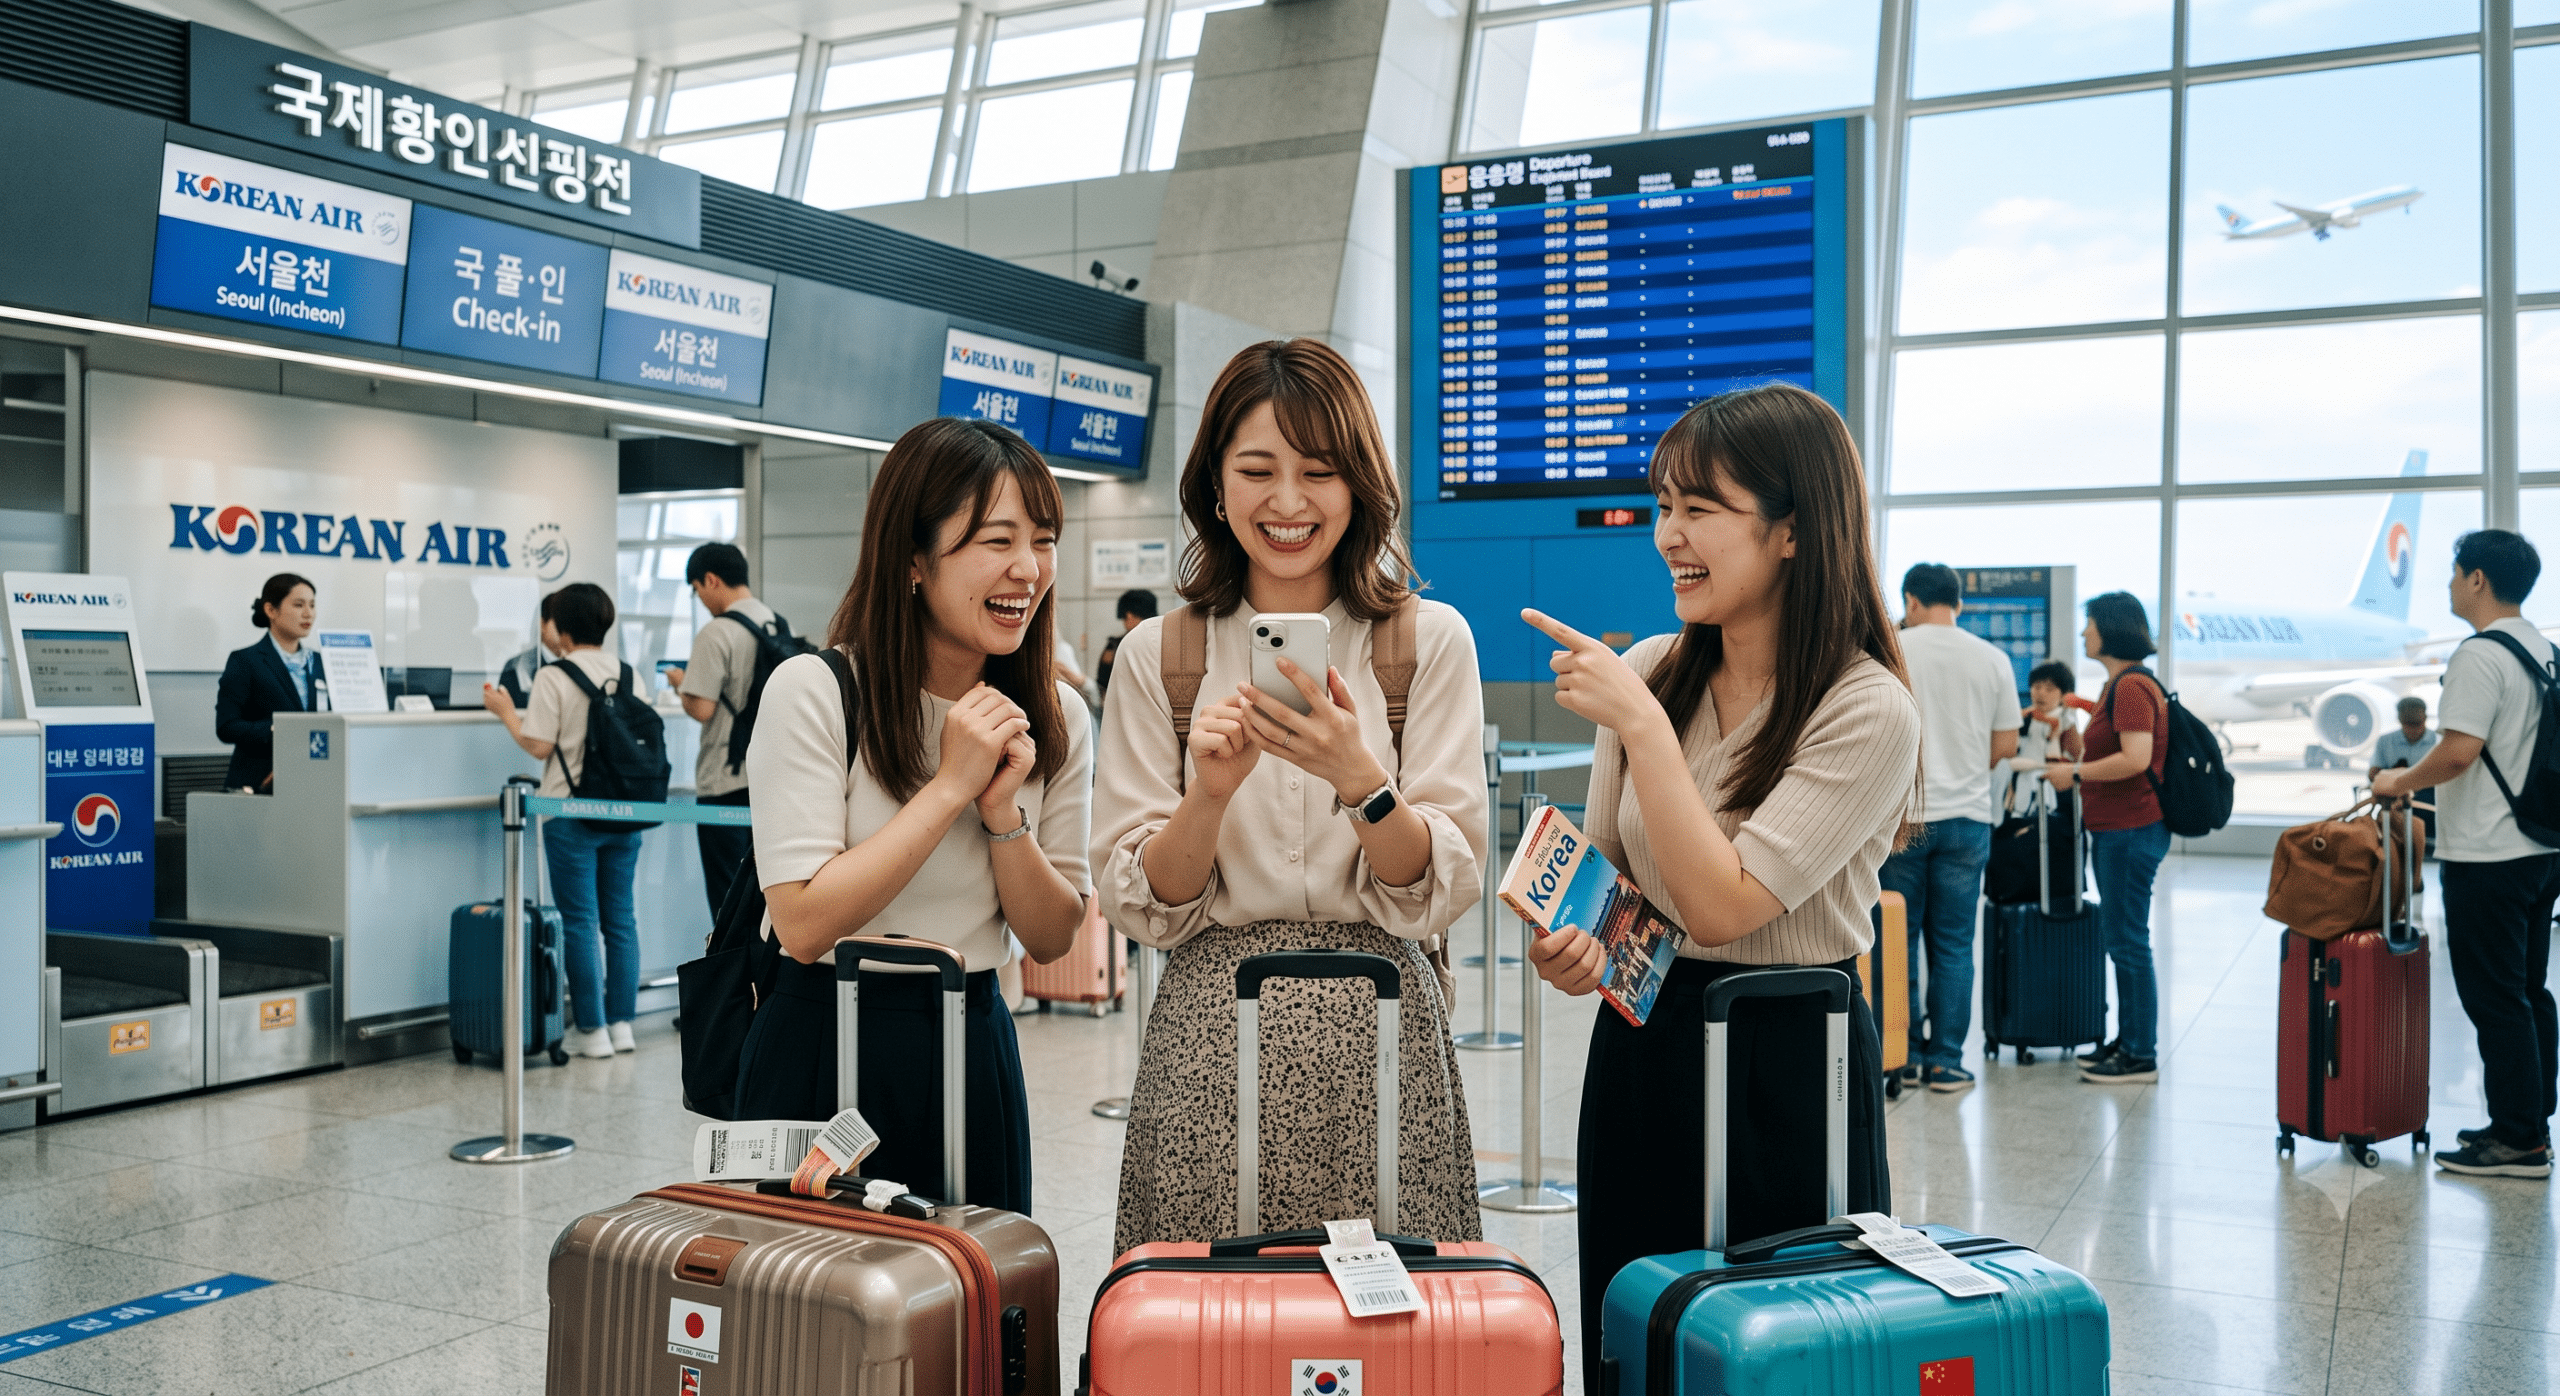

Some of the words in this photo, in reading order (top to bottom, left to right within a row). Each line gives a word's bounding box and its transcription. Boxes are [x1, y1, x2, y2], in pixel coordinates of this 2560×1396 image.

[175, 170, 304, 221] KOREAN
[310, 203, 364, 234] AIR
[235, 245, 332, 298] 서울천
[454, 246, 485, 291] 국
[216, 285, 265, 312] Seoul
[268, 294, 346, 330] (Incheon)
[617, 271, 701, 306] KOREAN
[703, 291, 741, 315] AIR
[452, 296, 561, 343] Check-in
[639, 361, 673, 382] Seoul
[950, 345, 1008, 372] KOREAN
[1009, 359, 1036, 379] AIR
[169, 503, 406, 563] KOREAN
[417, 521, 511, 569] AIR
[13, 591, 77, 606] KOREAN
[80, 593, 110, 607] AIR
[47, 748, 79, 768] 대부
[50, 852, 113, 870] KOREAN
[115, 850, 144, 866] AIR
[1526, 833, 1578, 911] Korea
